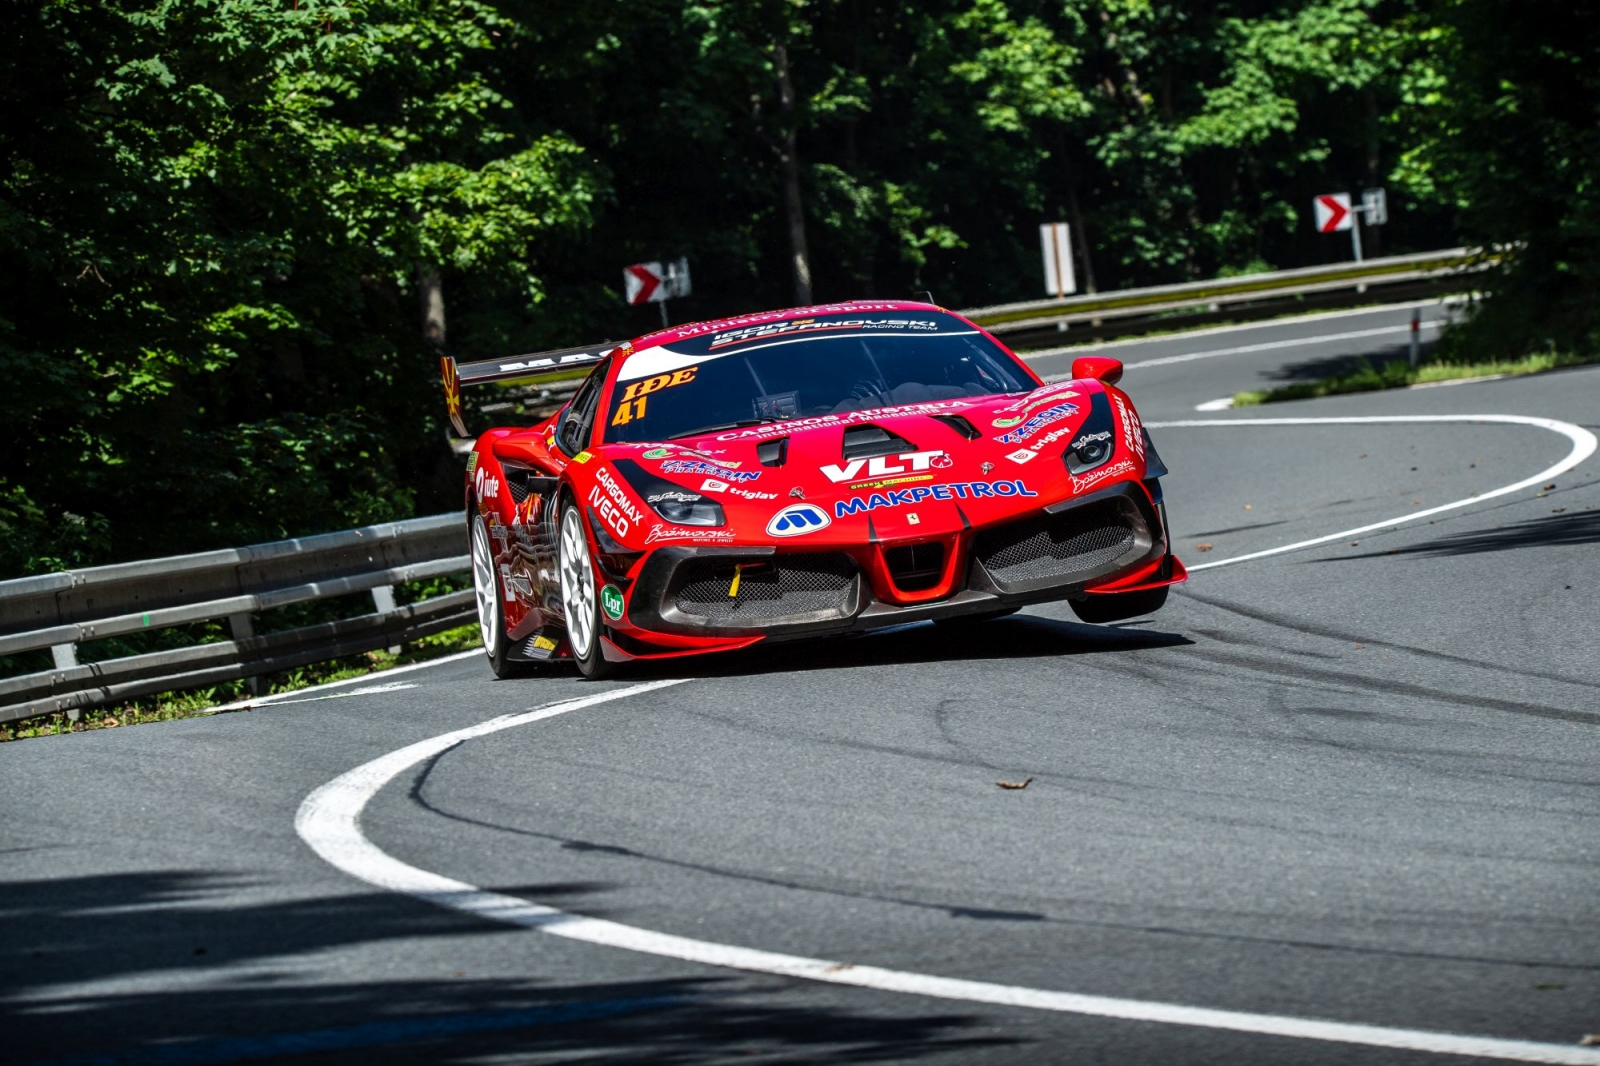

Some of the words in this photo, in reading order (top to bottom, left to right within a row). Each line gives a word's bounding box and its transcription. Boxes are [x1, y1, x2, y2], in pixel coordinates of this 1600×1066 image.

[678, 312, 786, 338] Ministry
[827, 303, 898, 313] Sport
[710, 320, 936, 348] STEFANOVSKI
[714, 321, 789, 341] IGOR
[611, 395, 648, 427] 41
[716, 414, 839, 442] CASINOS
[849, 400, 971, 419] AUSTRIA
[756, 416, 855, 440] International
[860, 408, 940, 422] Macedonia
[1030, 427, 1071, 450] triglav
[819, 449, 944, 483] VLT
[484, 470, 499, 498] iute
[595, 466, 644, 527] CARGOMAX
[729, 487, 779, 500] triglav
[834, 480, 1039, 518] MAKPETROL
[588, 484, 629, 538] IVECO
